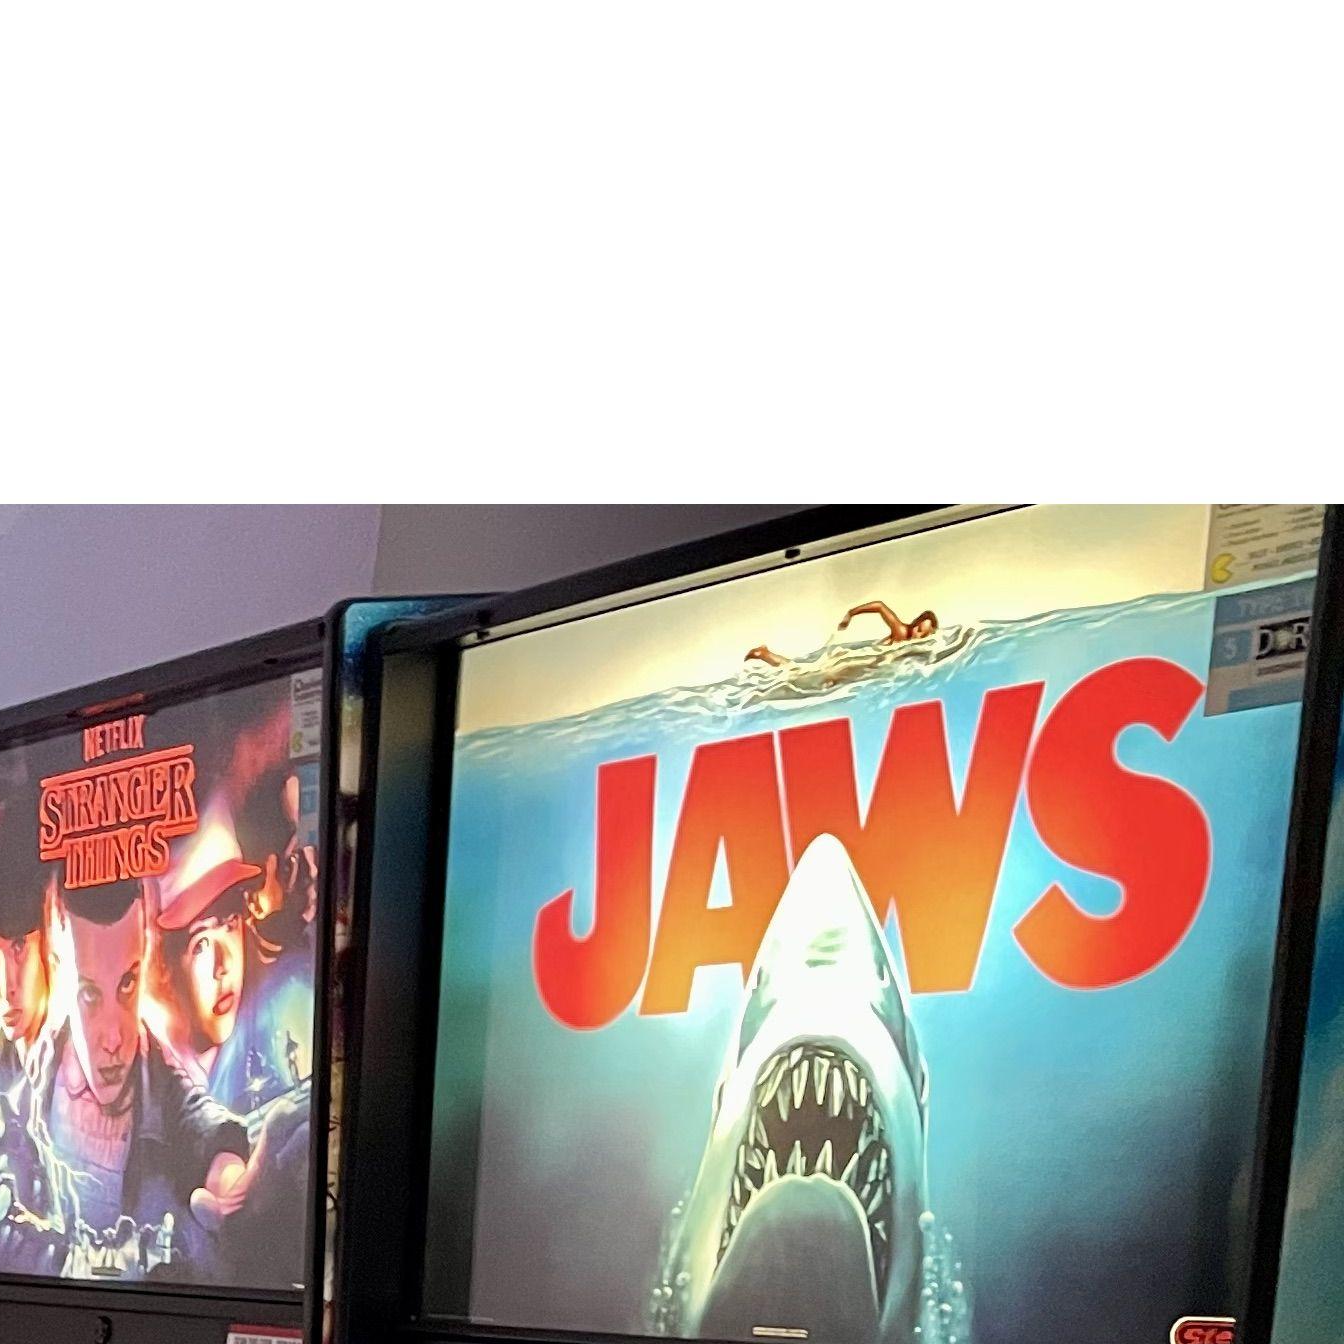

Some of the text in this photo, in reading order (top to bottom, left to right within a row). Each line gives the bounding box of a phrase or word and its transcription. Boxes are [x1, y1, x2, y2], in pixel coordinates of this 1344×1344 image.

[83, 714, 146, 762] NETFLIX
[40, 756, 198, 851] STRANGER
[532, 656, 1213, 1031] JAWS
[63, 821, 171, 889] THINGS
